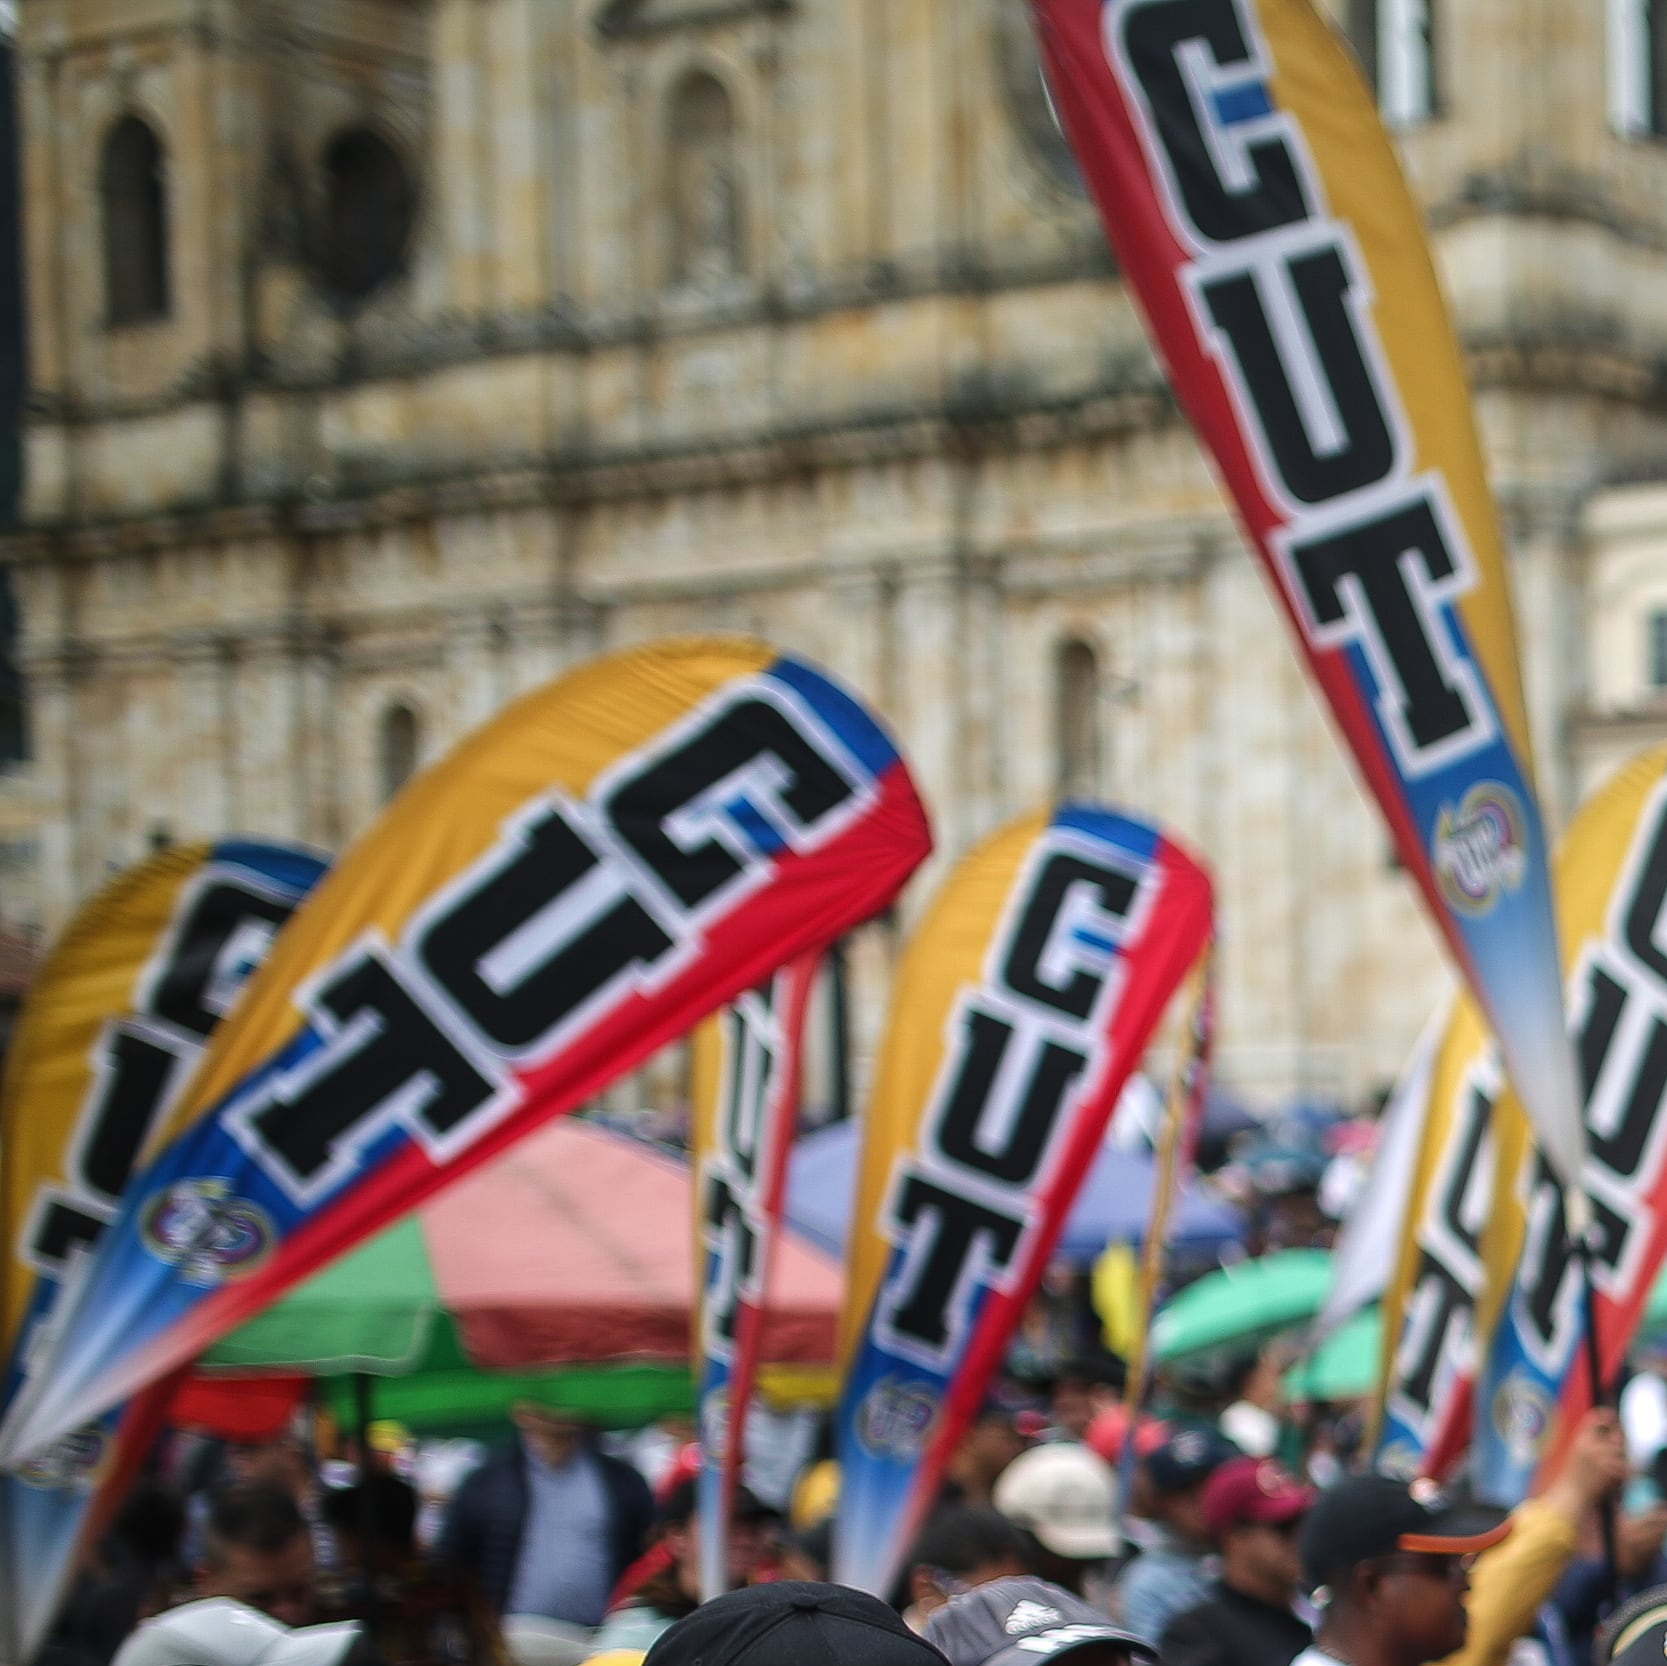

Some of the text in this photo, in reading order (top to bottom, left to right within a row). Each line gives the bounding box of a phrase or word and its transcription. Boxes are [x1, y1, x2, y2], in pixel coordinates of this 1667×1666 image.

[1117, 0, 1480, 760] CUT
[238, 688, 868, 1190] CUT
[887, 846, 1148, 1358] CUT
